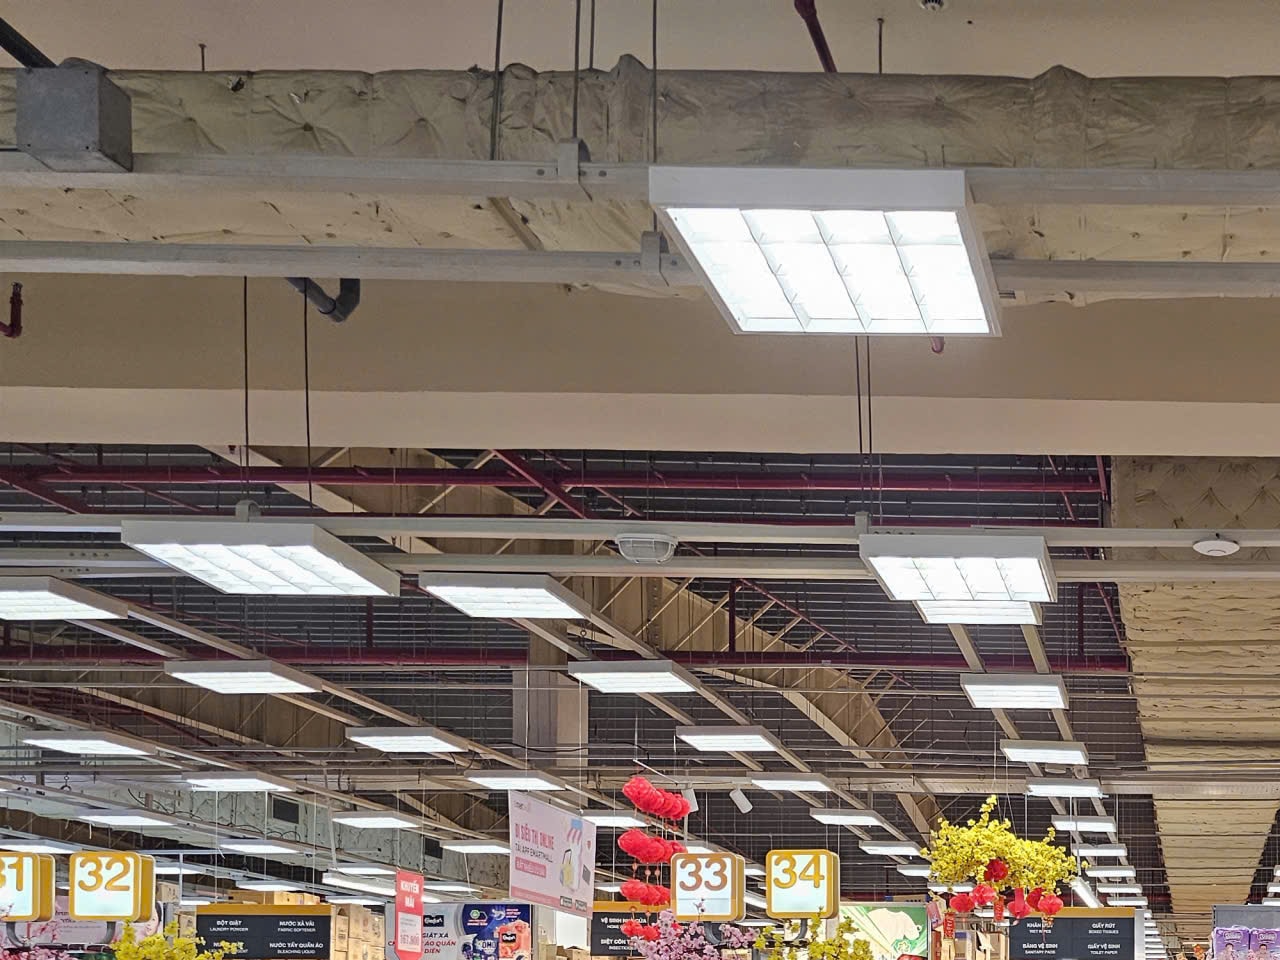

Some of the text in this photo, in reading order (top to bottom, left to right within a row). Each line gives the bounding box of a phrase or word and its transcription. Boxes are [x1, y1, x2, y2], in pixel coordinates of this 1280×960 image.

[0, 856, 24, 892] 1
[78, 854, 132, 892] 32
[679, 858, 728, 892] 33
[773, 855, 825, 890] 34
